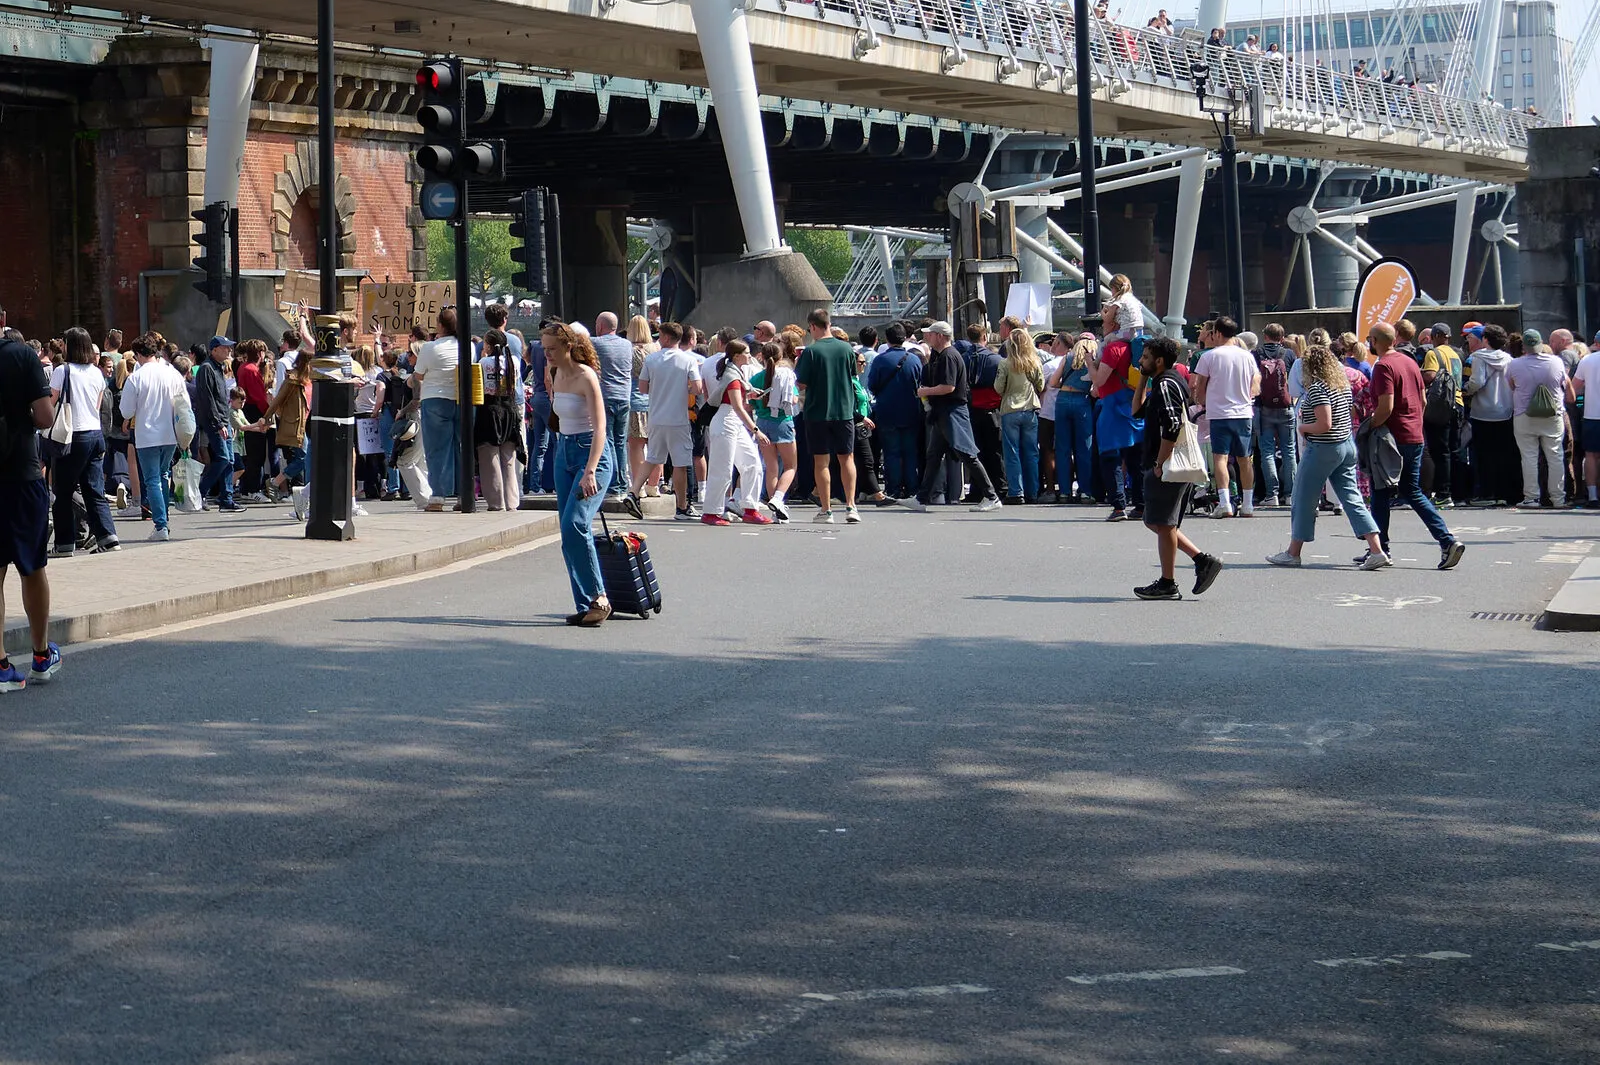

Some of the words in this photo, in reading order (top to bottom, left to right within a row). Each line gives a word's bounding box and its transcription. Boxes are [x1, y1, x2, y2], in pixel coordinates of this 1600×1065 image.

[378, 284, 428, 298] JUST
[444, 284, 451, 297] A
[1392, 275, 1408, 293] UK
[392, 300, 400, 315] 9
[407, 300, 437, 313] TOE
